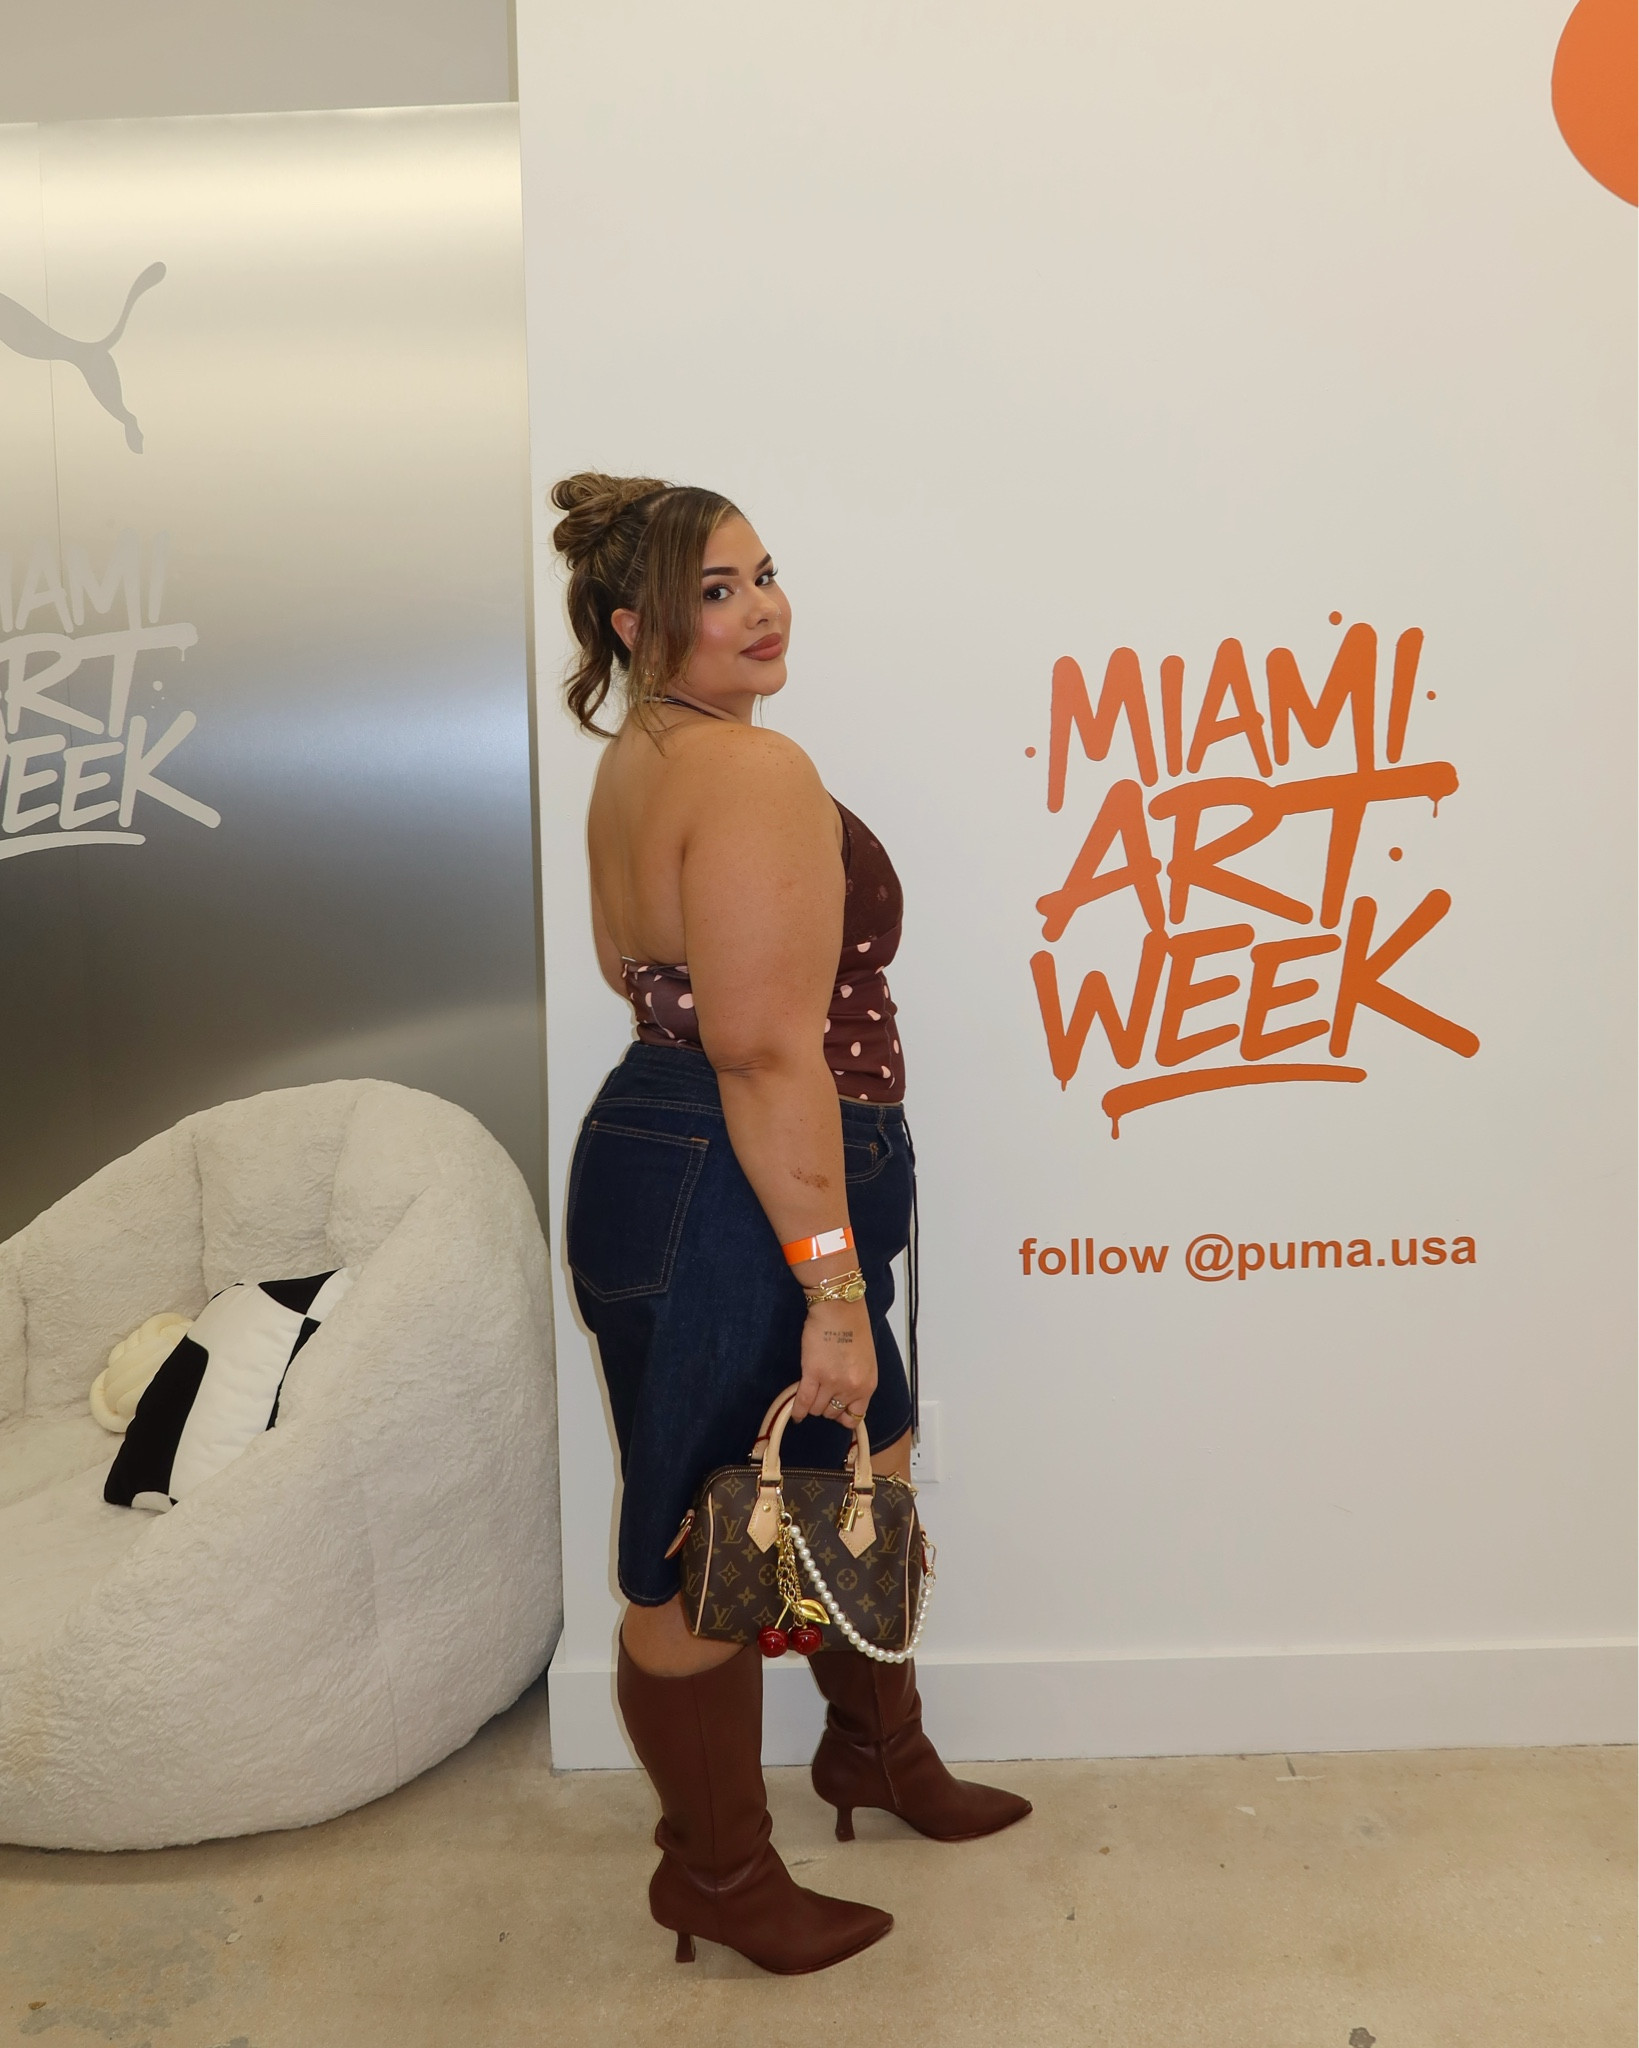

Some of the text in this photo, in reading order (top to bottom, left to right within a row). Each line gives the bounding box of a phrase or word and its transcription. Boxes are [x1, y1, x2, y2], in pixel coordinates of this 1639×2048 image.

[0, 527, 171, 633] IAMI
[0, 622, 199, 738] RT
[1047, 622, 1425, 813] MIAMI
[0, 710, 221, 833] EEK
[1035, 761, 1460, 943] ART
[1029, 888, 1481, 1091] WEEK
[1019, 1233, 1477, 1282] follow @puma.usa
